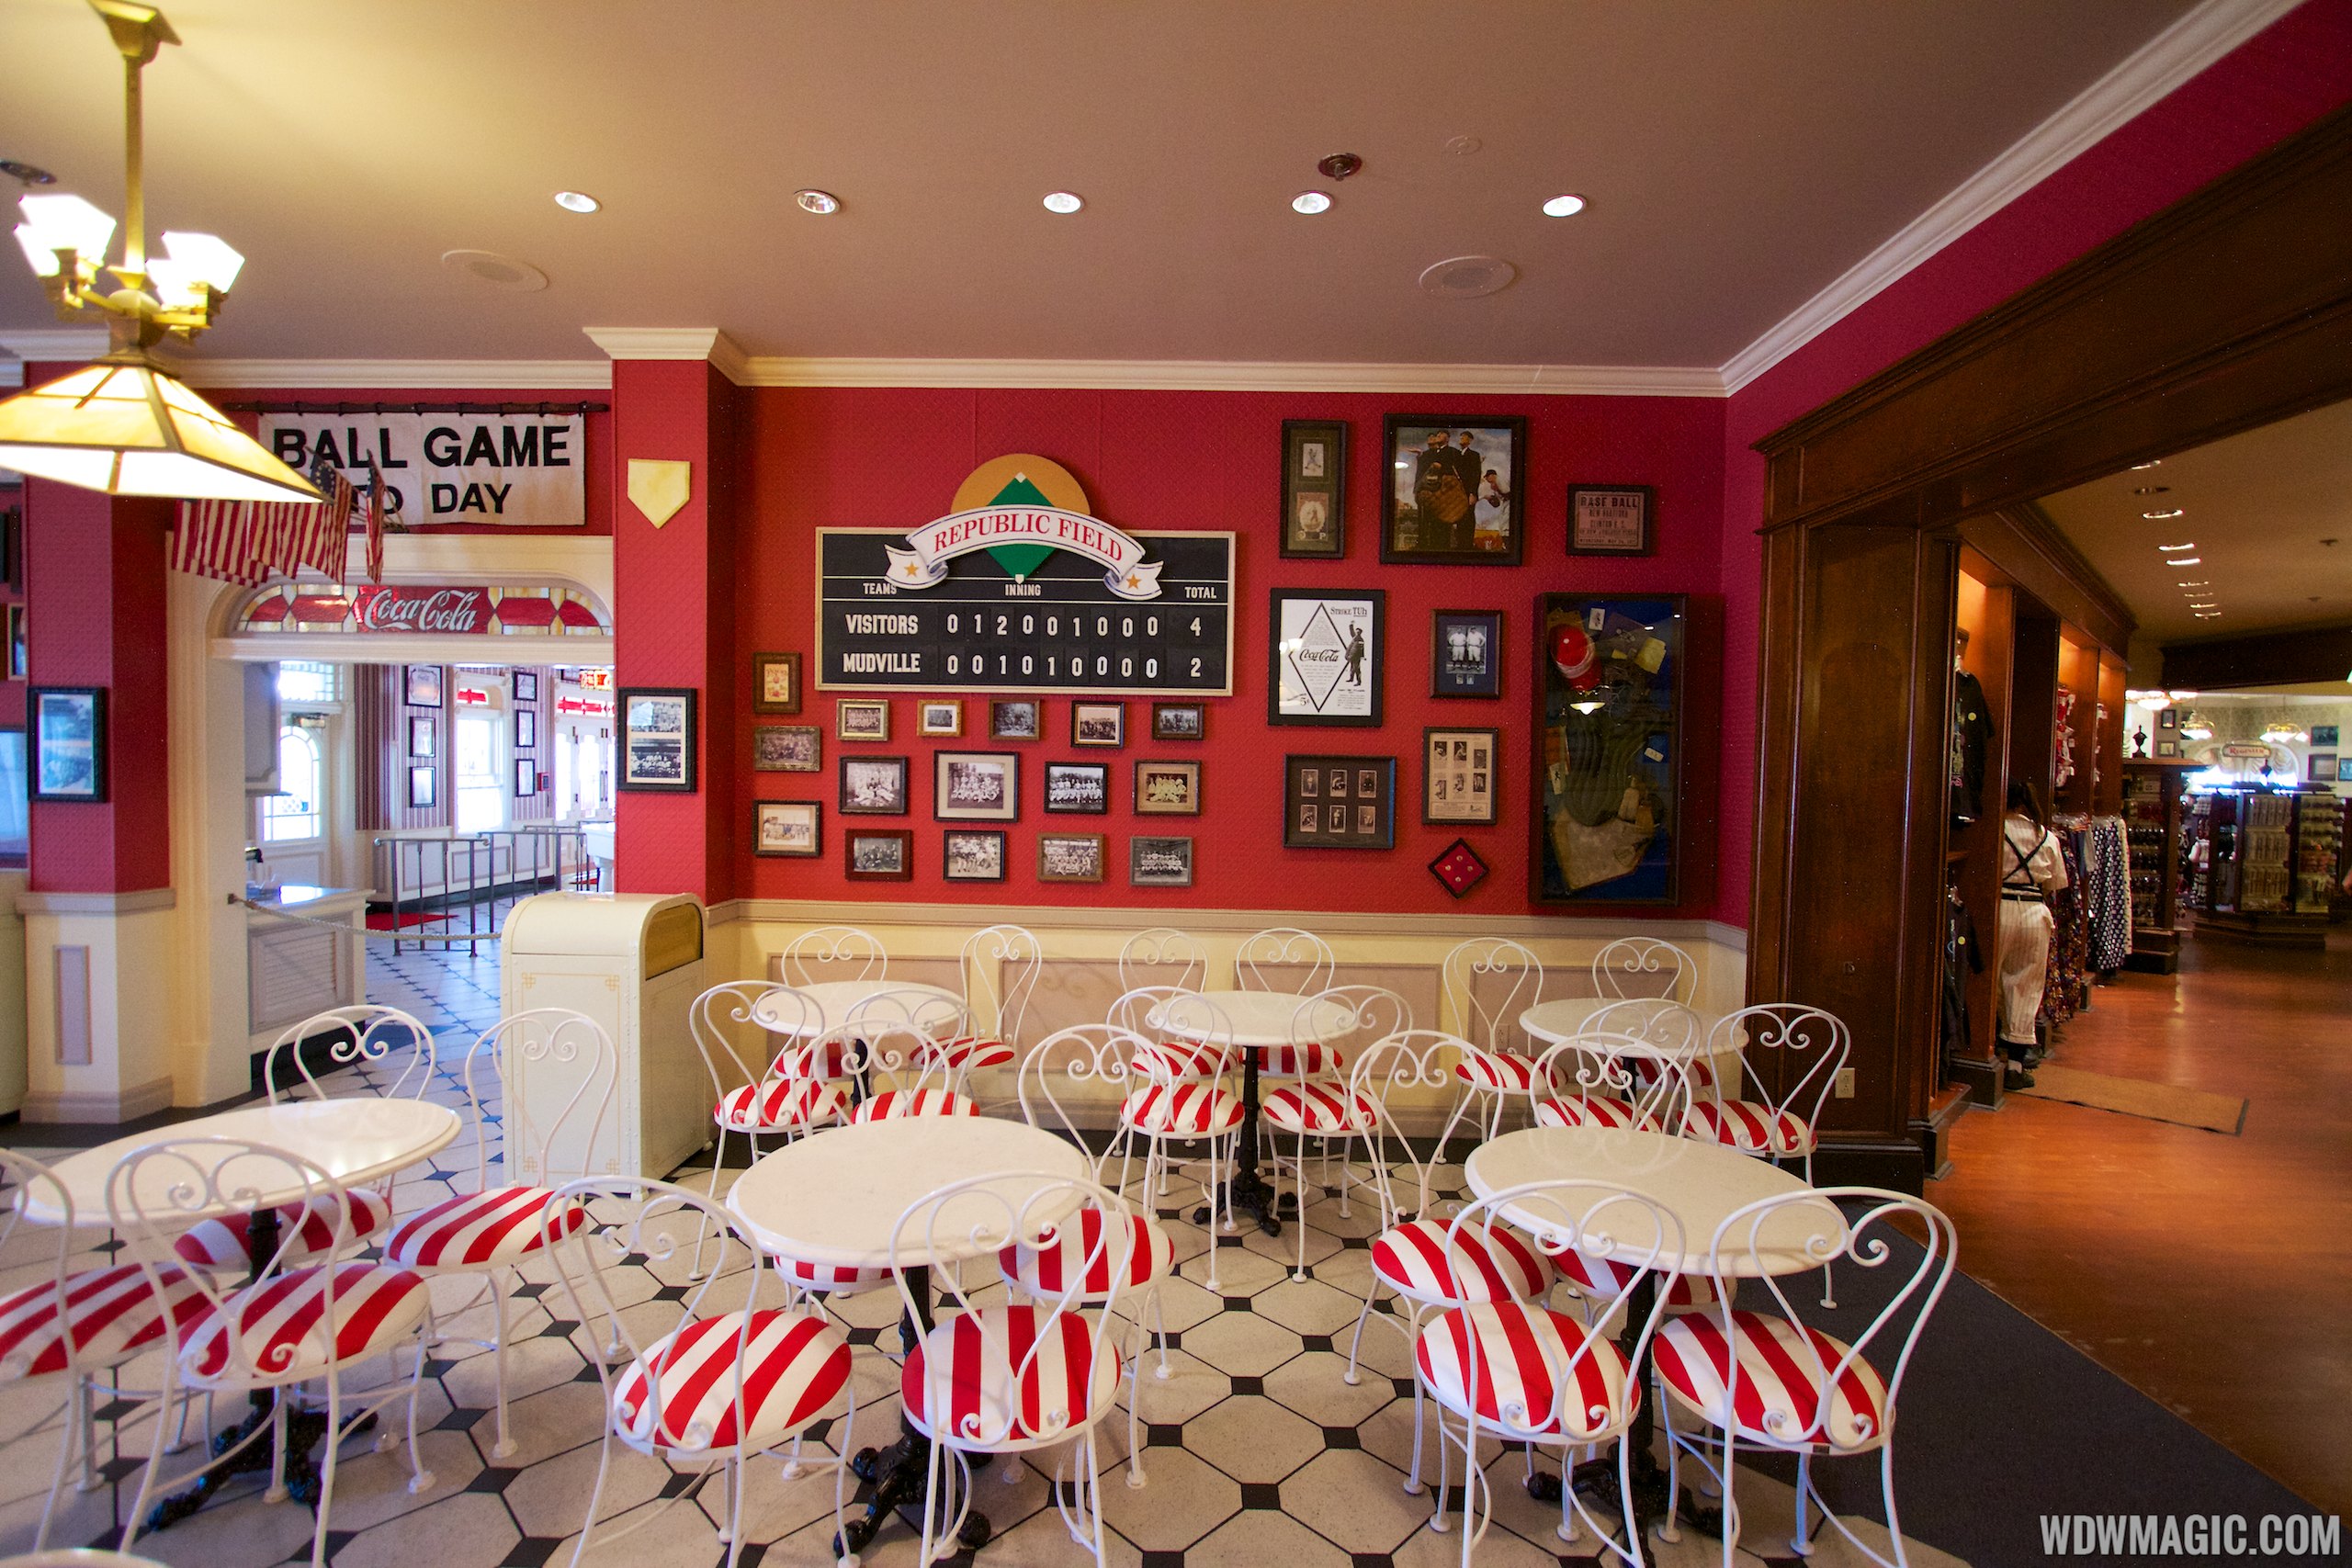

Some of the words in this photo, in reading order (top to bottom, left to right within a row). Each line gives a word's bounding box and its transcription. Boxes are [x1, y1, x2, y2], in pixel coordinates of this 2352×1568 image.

[274, 427, 408, 468] BALL
[424, 425, 571, 468] GAME
[431, 483, 512, 514] DAY
[1611, 497, 1638, 508] BALL
[933, 513, 1051, 553] REPUBLIC
[1057, 517, 1123, 561] FIELD
[862, 582, 898, 595] TEAMS
[1004, 583, 1042, 596] INNING
[1184, 586, 1217, 599] TOTAL
[844, 614, 919, 635] VISITORS
[947, 615, 957, 634] 0
[974, 615, 982, 634] 1
[997, 615, 1008, 636] 2
[1022, 615, 1033, 635] 0
[1047, 616, 1057, 637] 0
[1072, 617, 1080, 637] 1
[1097, 617, 1108, 637] 0
[1122, 617, 1133, 637] 0
[1147, 616, 1159, 637] 0
[1190, 616, 1202, 637] 4
[842, 652, 921, 673] MUDVILLE
[947, 655, 958, 674] 0
[972, 655, 983, 674] 0
[999, 656, 1007, 674] 1
[1022, 656, 1033, 675] 0
[1047, 657, 1056, 676] 1
[1072, 658, 1083, 677] 0
[1096, 656, 1108, 676] 0
[1121, 658, 1133, 677] 0
[1146, 658, 1158, 678] 0
[1190, 658, 1202, 677] 2
